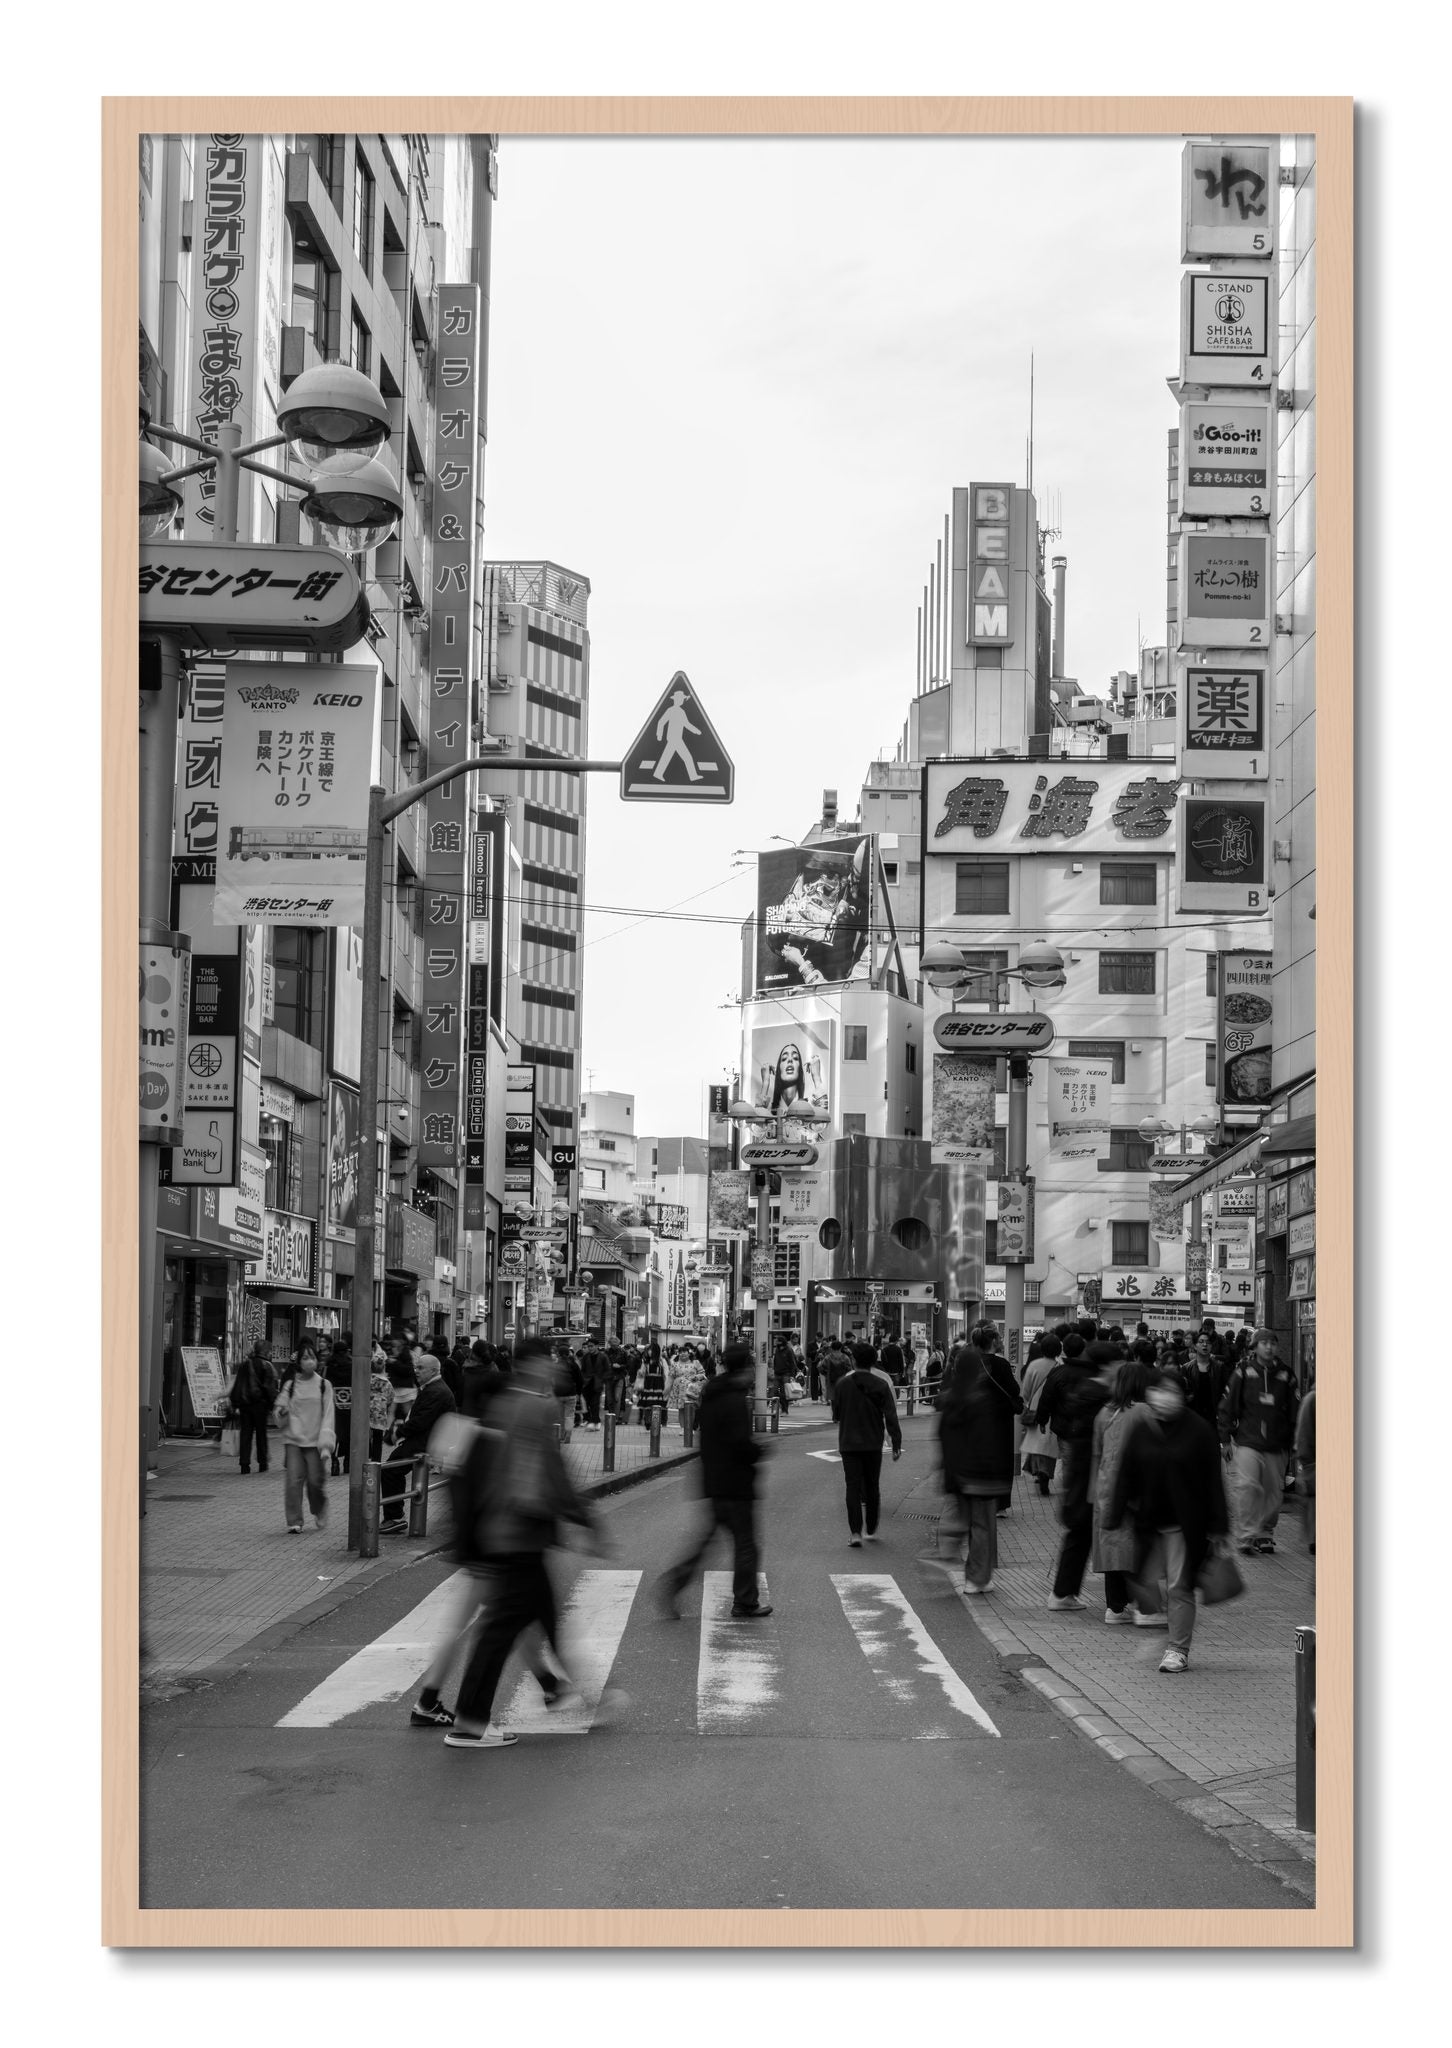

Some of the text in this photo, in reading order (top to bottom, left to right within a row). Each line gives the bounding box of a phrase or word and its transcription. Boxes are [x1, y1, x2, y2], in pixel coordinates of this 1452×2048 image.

[203, 146, 247, 290] カラオケ
[1252, 235, 1265, 250] 5
[1207, 283, 1253, 293] C.STAND
[1207, 325, 1253, 336] SHISHA
[1207, 337, 1253, 345] CAFE&BAR
[1251, 365, 1263, 380] 4
[1193, 472, 1262, 484] 全身もみほぐし
[1250, 495, 1262, 512] 3
[976, 487, 1008, 637] BEAM
[1193, 568, 1260, 589] ポムの樹
[1250, 626, 1262, 642] 2
[313, 693, 363, 707] KEIO
[1198, 676, 1249, 728] 薬
[1191, 732, 1255, 746] マツモトキヨシ
[255, 730, 272, 774] 冒険へ
[274, 731, 293, 807] カントーの
[318, 731, 335, 792] 京王線で
[1249, 759, 1257, 774] 1
[934, 775, 1179, 838] 角海老
[1192, 816, 1253, 865] 一蘭
[477, 837, 486, 874] kimono
[243, 897, 334, 911] 渋谷センター街
[1248, 891, 1259, 906] B
[941, 1023, 1047, 1036] 渋谷センター街
[1225, 1032, 1254, 1051] 6F
[147, 1082, 167, 1096] Day!
[184, 1149, 217, 1160] Whisky
[554, 1152, 574, 1163] GU
[183, 1159, 203, 1167] Bank
[676, 1273, 685, 1317] BEER
